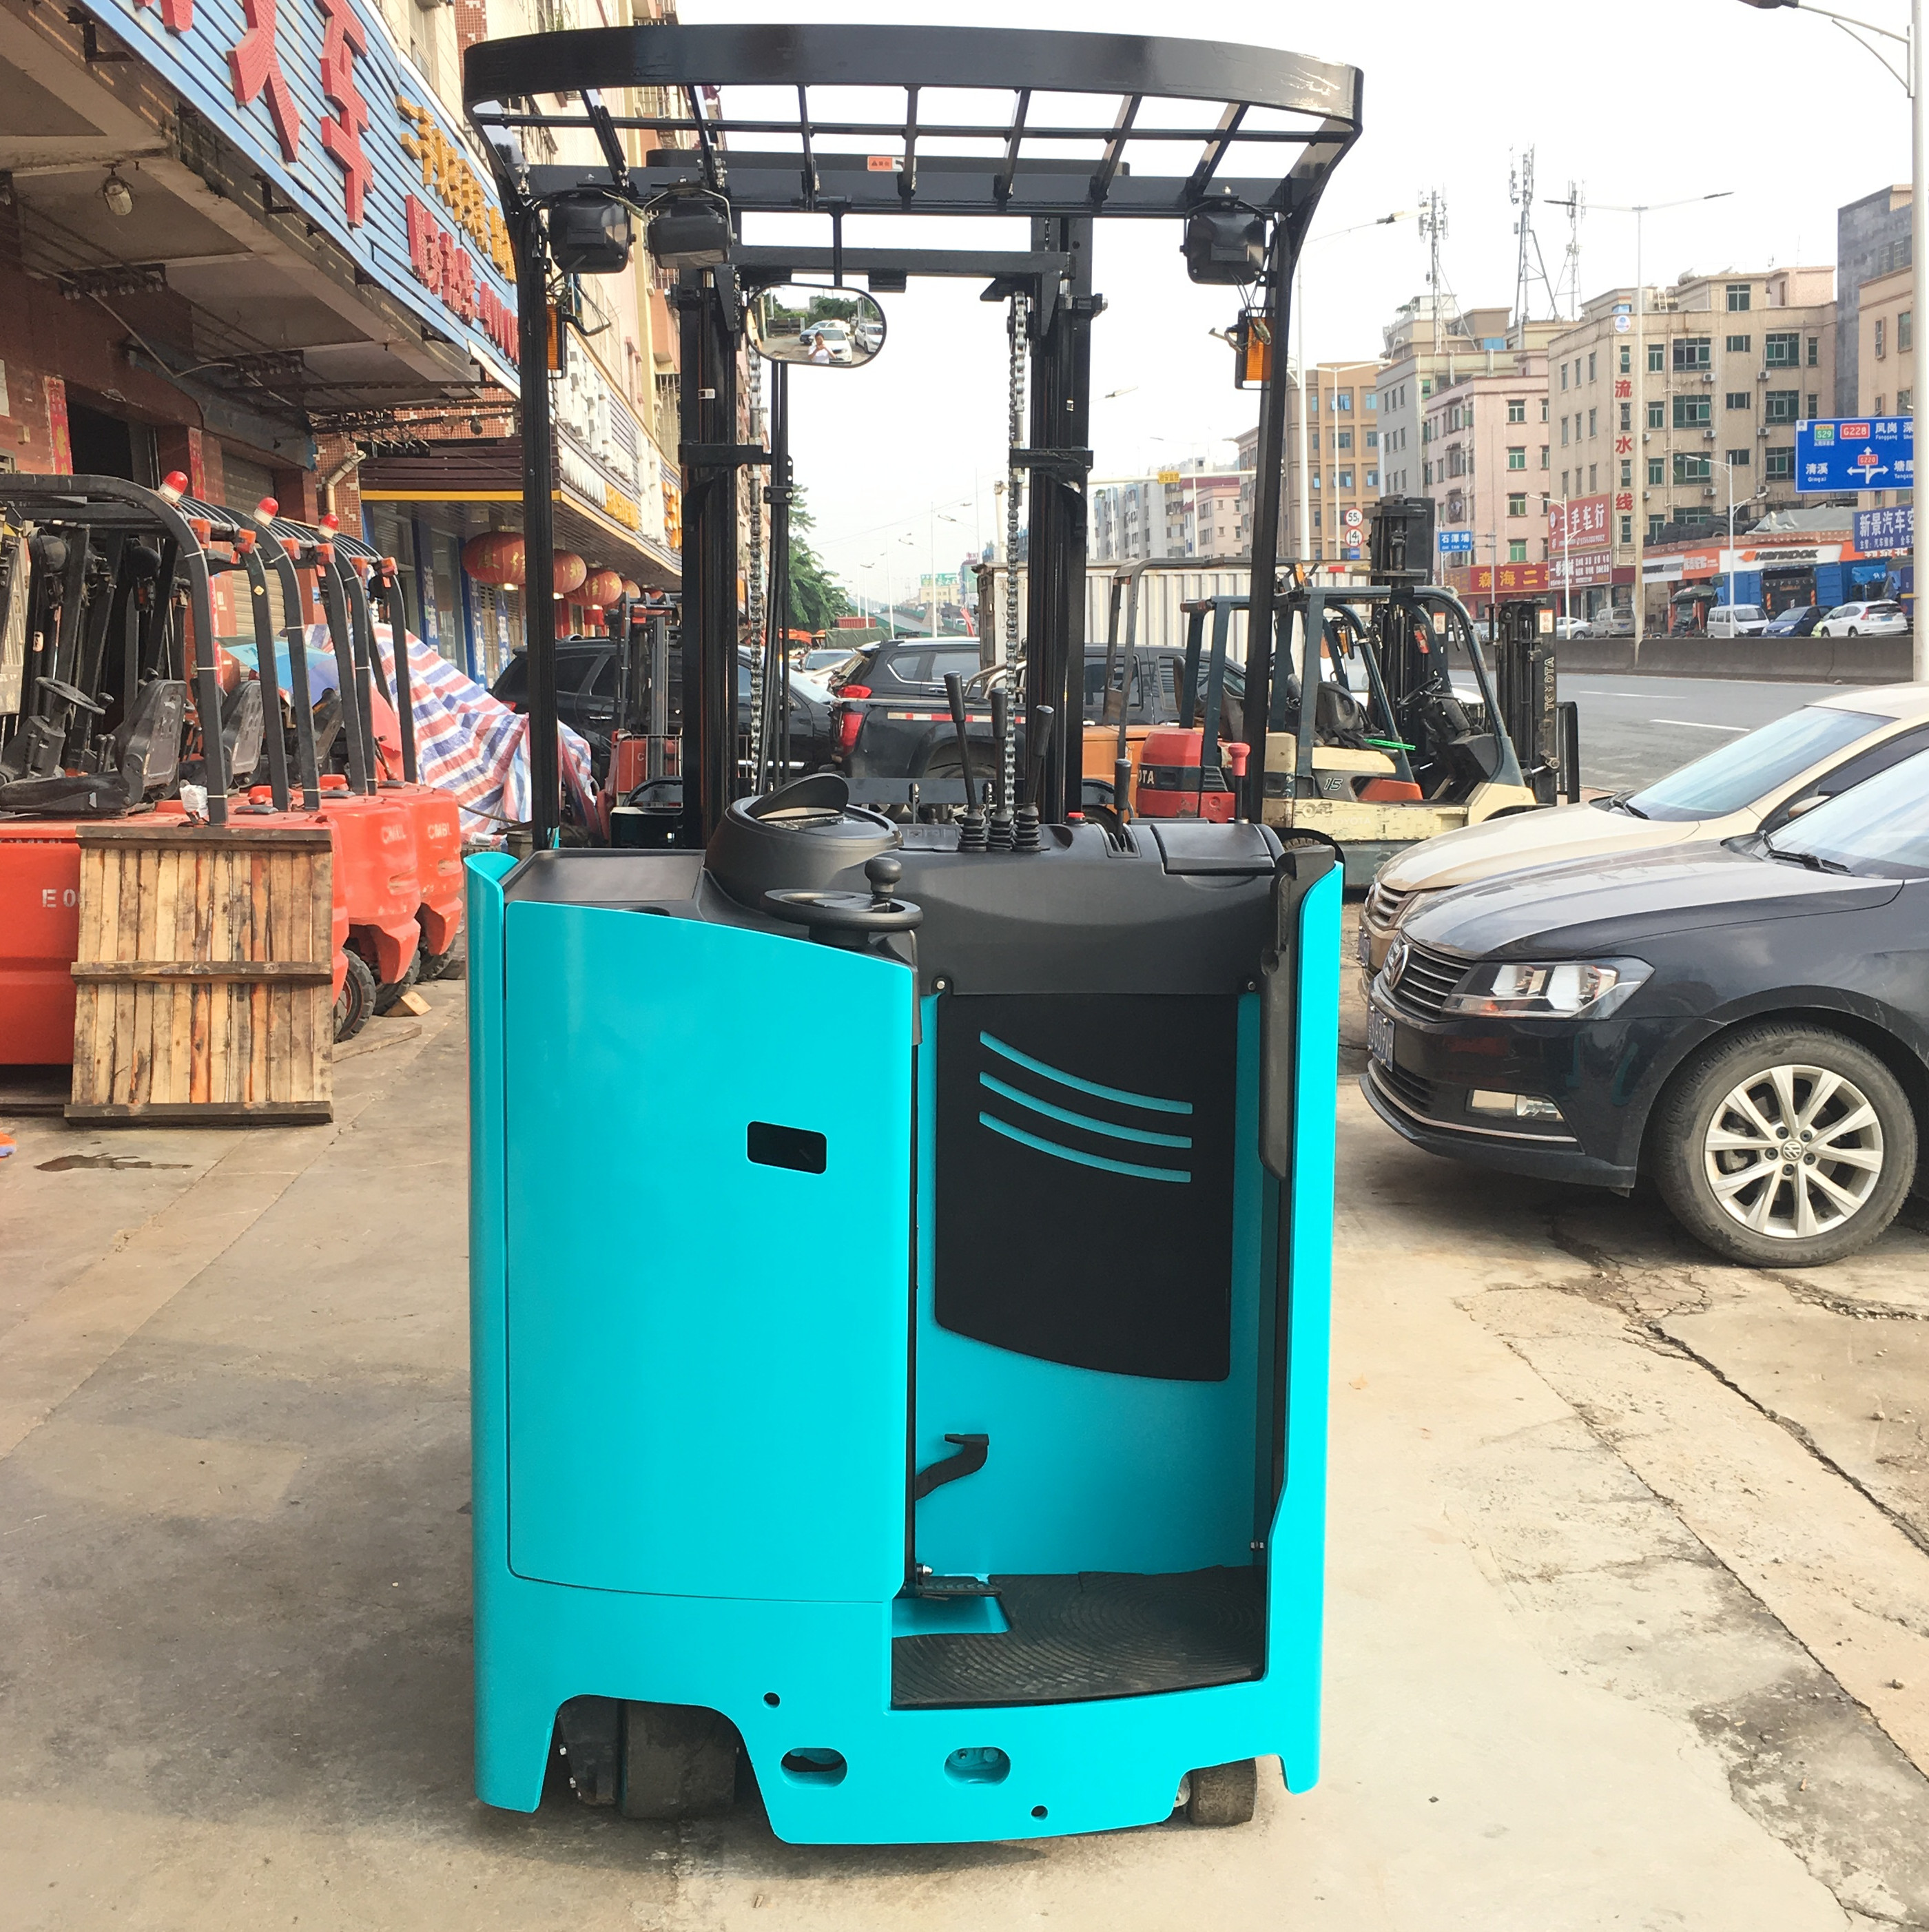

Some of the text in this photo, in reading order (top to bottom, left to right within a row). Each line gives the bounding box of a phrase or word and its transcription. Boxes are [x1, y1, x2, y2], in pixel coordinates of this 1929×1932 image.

[1817, 430, 1832, 439] S29
[1843, 426, 1867, 436] G228
[1875, 422, 1897, 434] 凤岗
[1614, 380, 1633, 511] 流水线
[1805, 462, 1828, 475] 清溪
[1544, 656, 1555, 711] TOYOTA
[1323, 778, 1343, 791] 15
